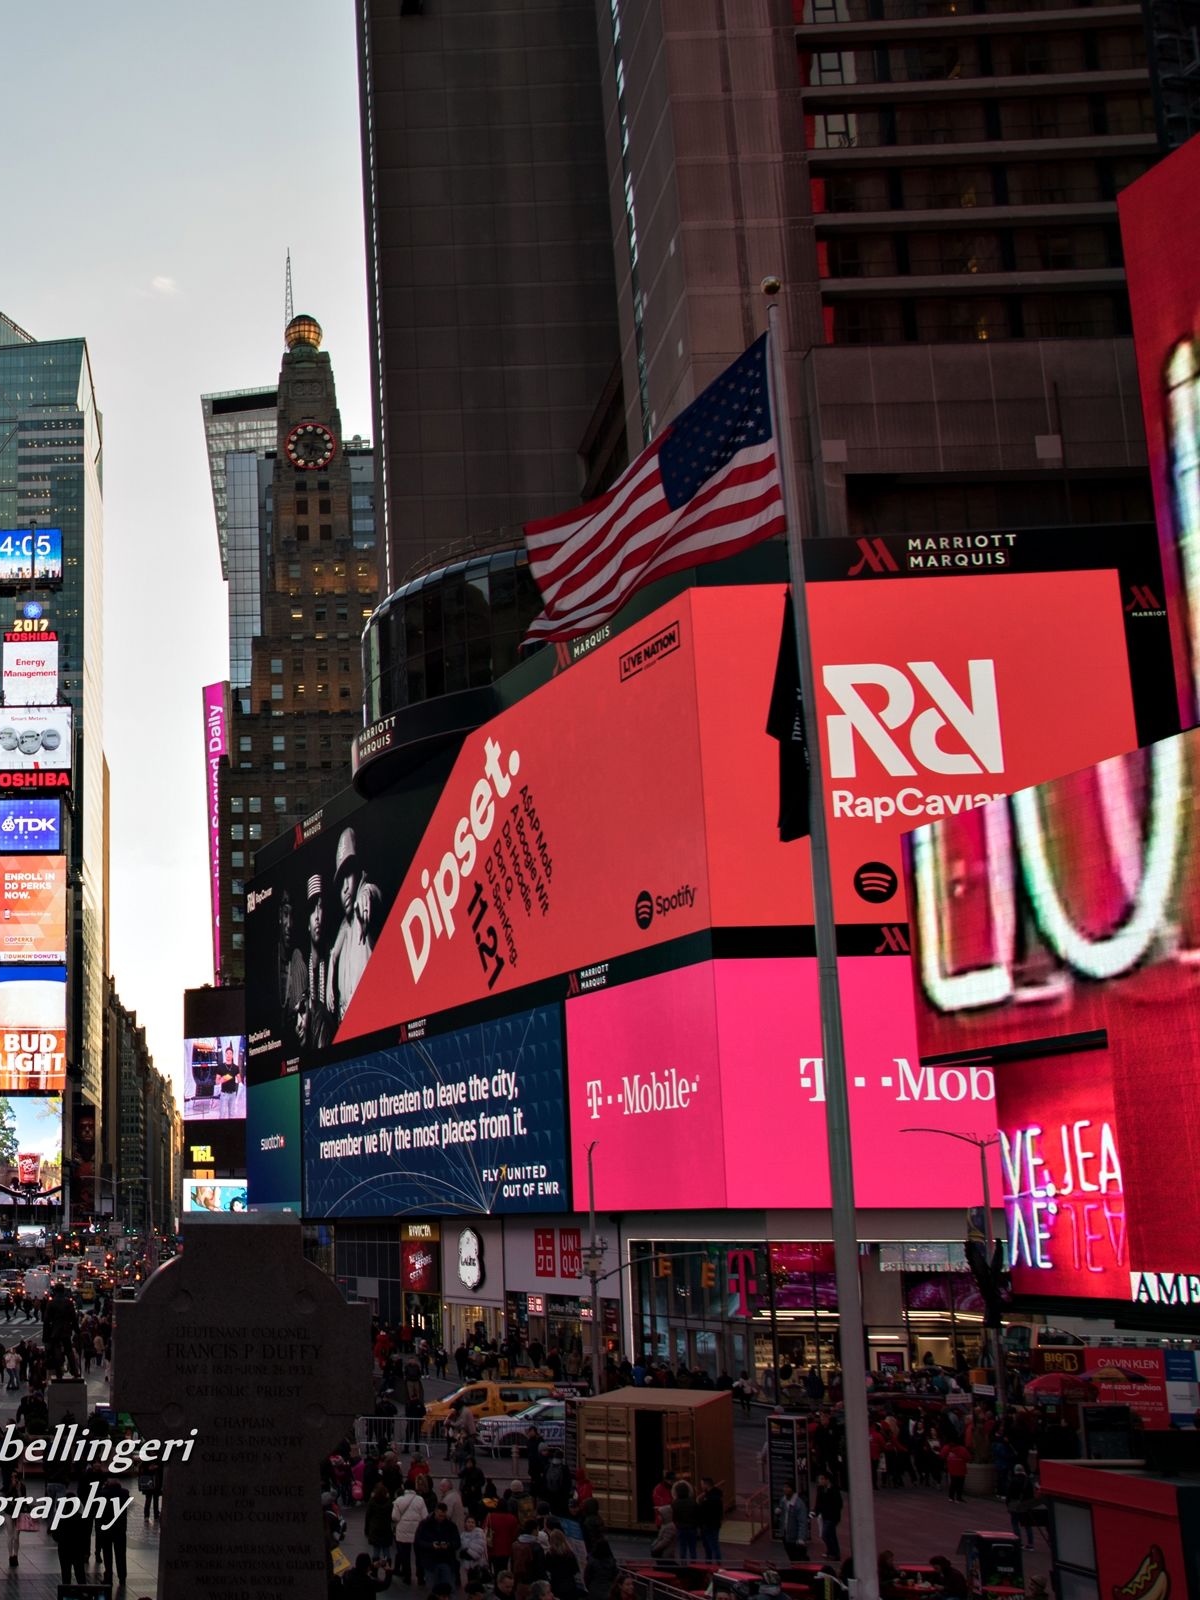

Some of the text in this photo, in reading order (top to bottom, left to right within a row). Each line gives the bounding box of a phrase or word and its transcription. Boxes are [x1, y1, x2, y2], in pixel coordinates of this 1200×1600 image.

[0, 535, 51, 556] 4:05
[908, 534, 1017, 551] MARRIOTT
[909, 551, 1006, 568] MARQUIS
[13, 619, 49, 632] 2017
[4, 632, 57, 641] TOSHIBA
[573, 625, 611, 658] MARQUIS
[622, 630, 677, 674] LIVE NATION
[15, 658, 46, 668] Energy
[3, 669, 57, 679] Management
[208, 704, 223, 752] Daily
[358, 716, 397, 745] MARRIOTT
[358, 733, 392, 761] MARQUIS
[14, 817, 57, 832] TDK
[515, 816, 538, 881] Boogie
[401, 736, 520, 985] Dipset.
[4, 872, 56, 881] ENROLL IN
[509, 845, 532, 918] Hoodie.
[4, 882, 52, 890] DD PERKS
[4, 891, 31, 899] NOW.
[655, 885, 695, 916] Spotify
[492, 882, 518, 968] Spinking.
[581, 963, 609, 979] MARRIOTT
[581, 975, 607, 990] MARQUIS
[3, 1033, 58, 1052] BUD
[319, 1069, 519, 1128] Next time you threaten to leave the city,
[261, 1134, 281, 1151] swatch
[319, 1111, 528, 1159] remember we fly the most places from it.
[1061, 1119, 1124, 1195] JEA
[482, 1165, 547, 1183] FLY UNITED
[503, 1181, 560, 1198] OUT OF EWR
[176, 1326, 311, 1340] LIEUTENANT COLONEL
[167, 1343, 322, 1360] FRANCIS DUFFY
[1098, 1358, 1159, 1369] CALVIN KLEIN
[256, 1384, 303, 1397] PRIEST
[1132, 1383, 1162, 1392] Fashion
[254, 1486, 304, 1498] SERVICE
[248, 1511, 308, 1523] COUNTRY
